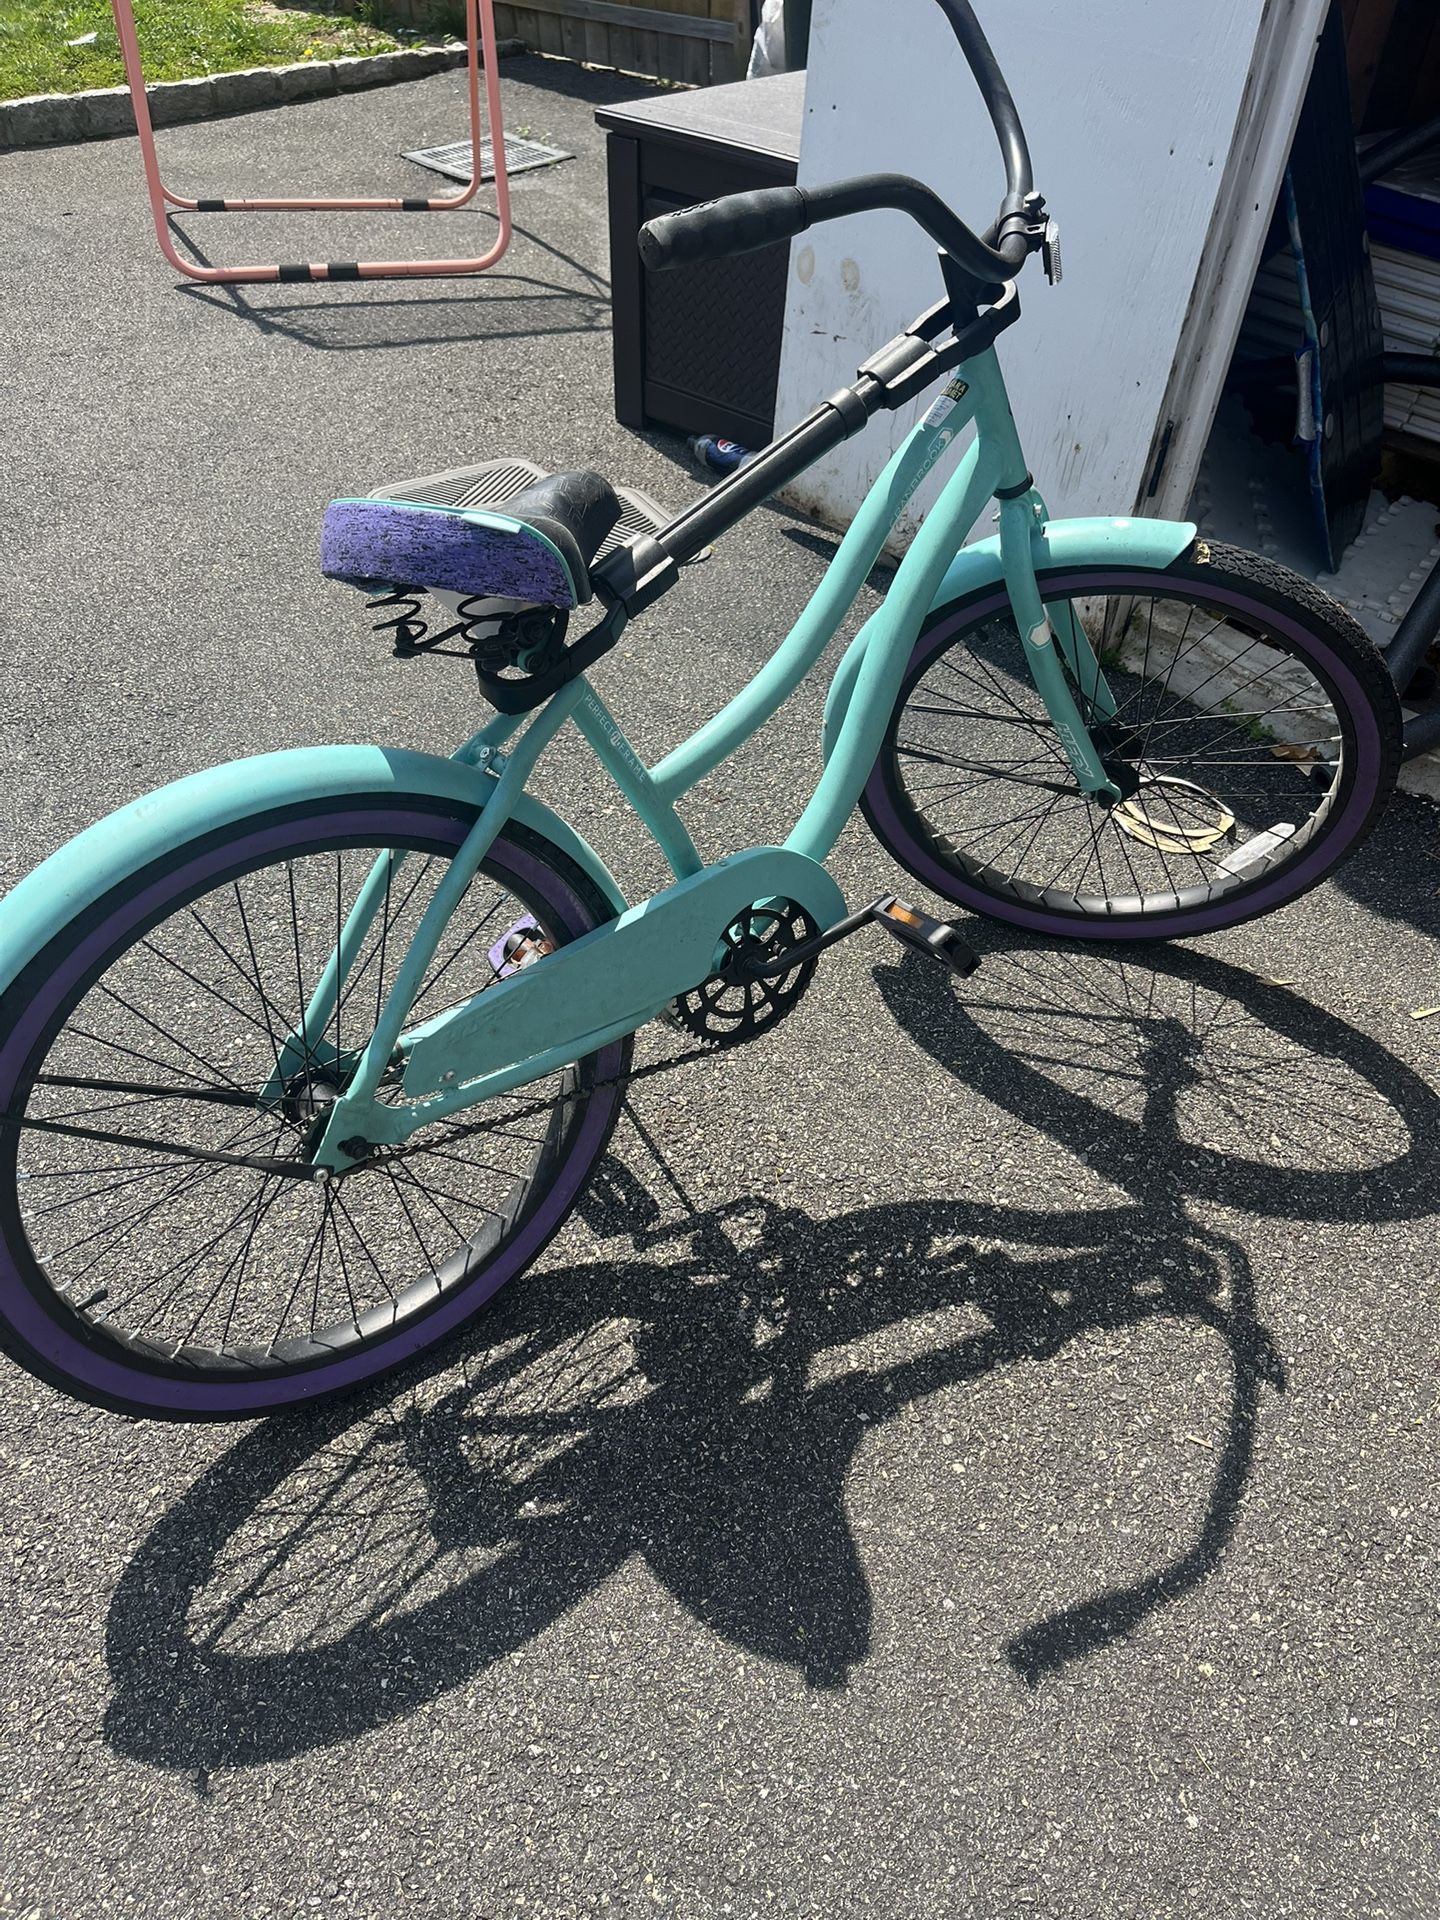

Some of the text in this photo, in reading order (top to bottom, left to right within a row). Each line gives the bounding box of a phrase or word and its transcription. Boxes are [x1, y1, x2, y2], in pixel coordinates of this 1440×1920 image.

[585, 694, 646, 782] PERFECT FRAME
[1054, 720, 1095, 778] HUFFY
